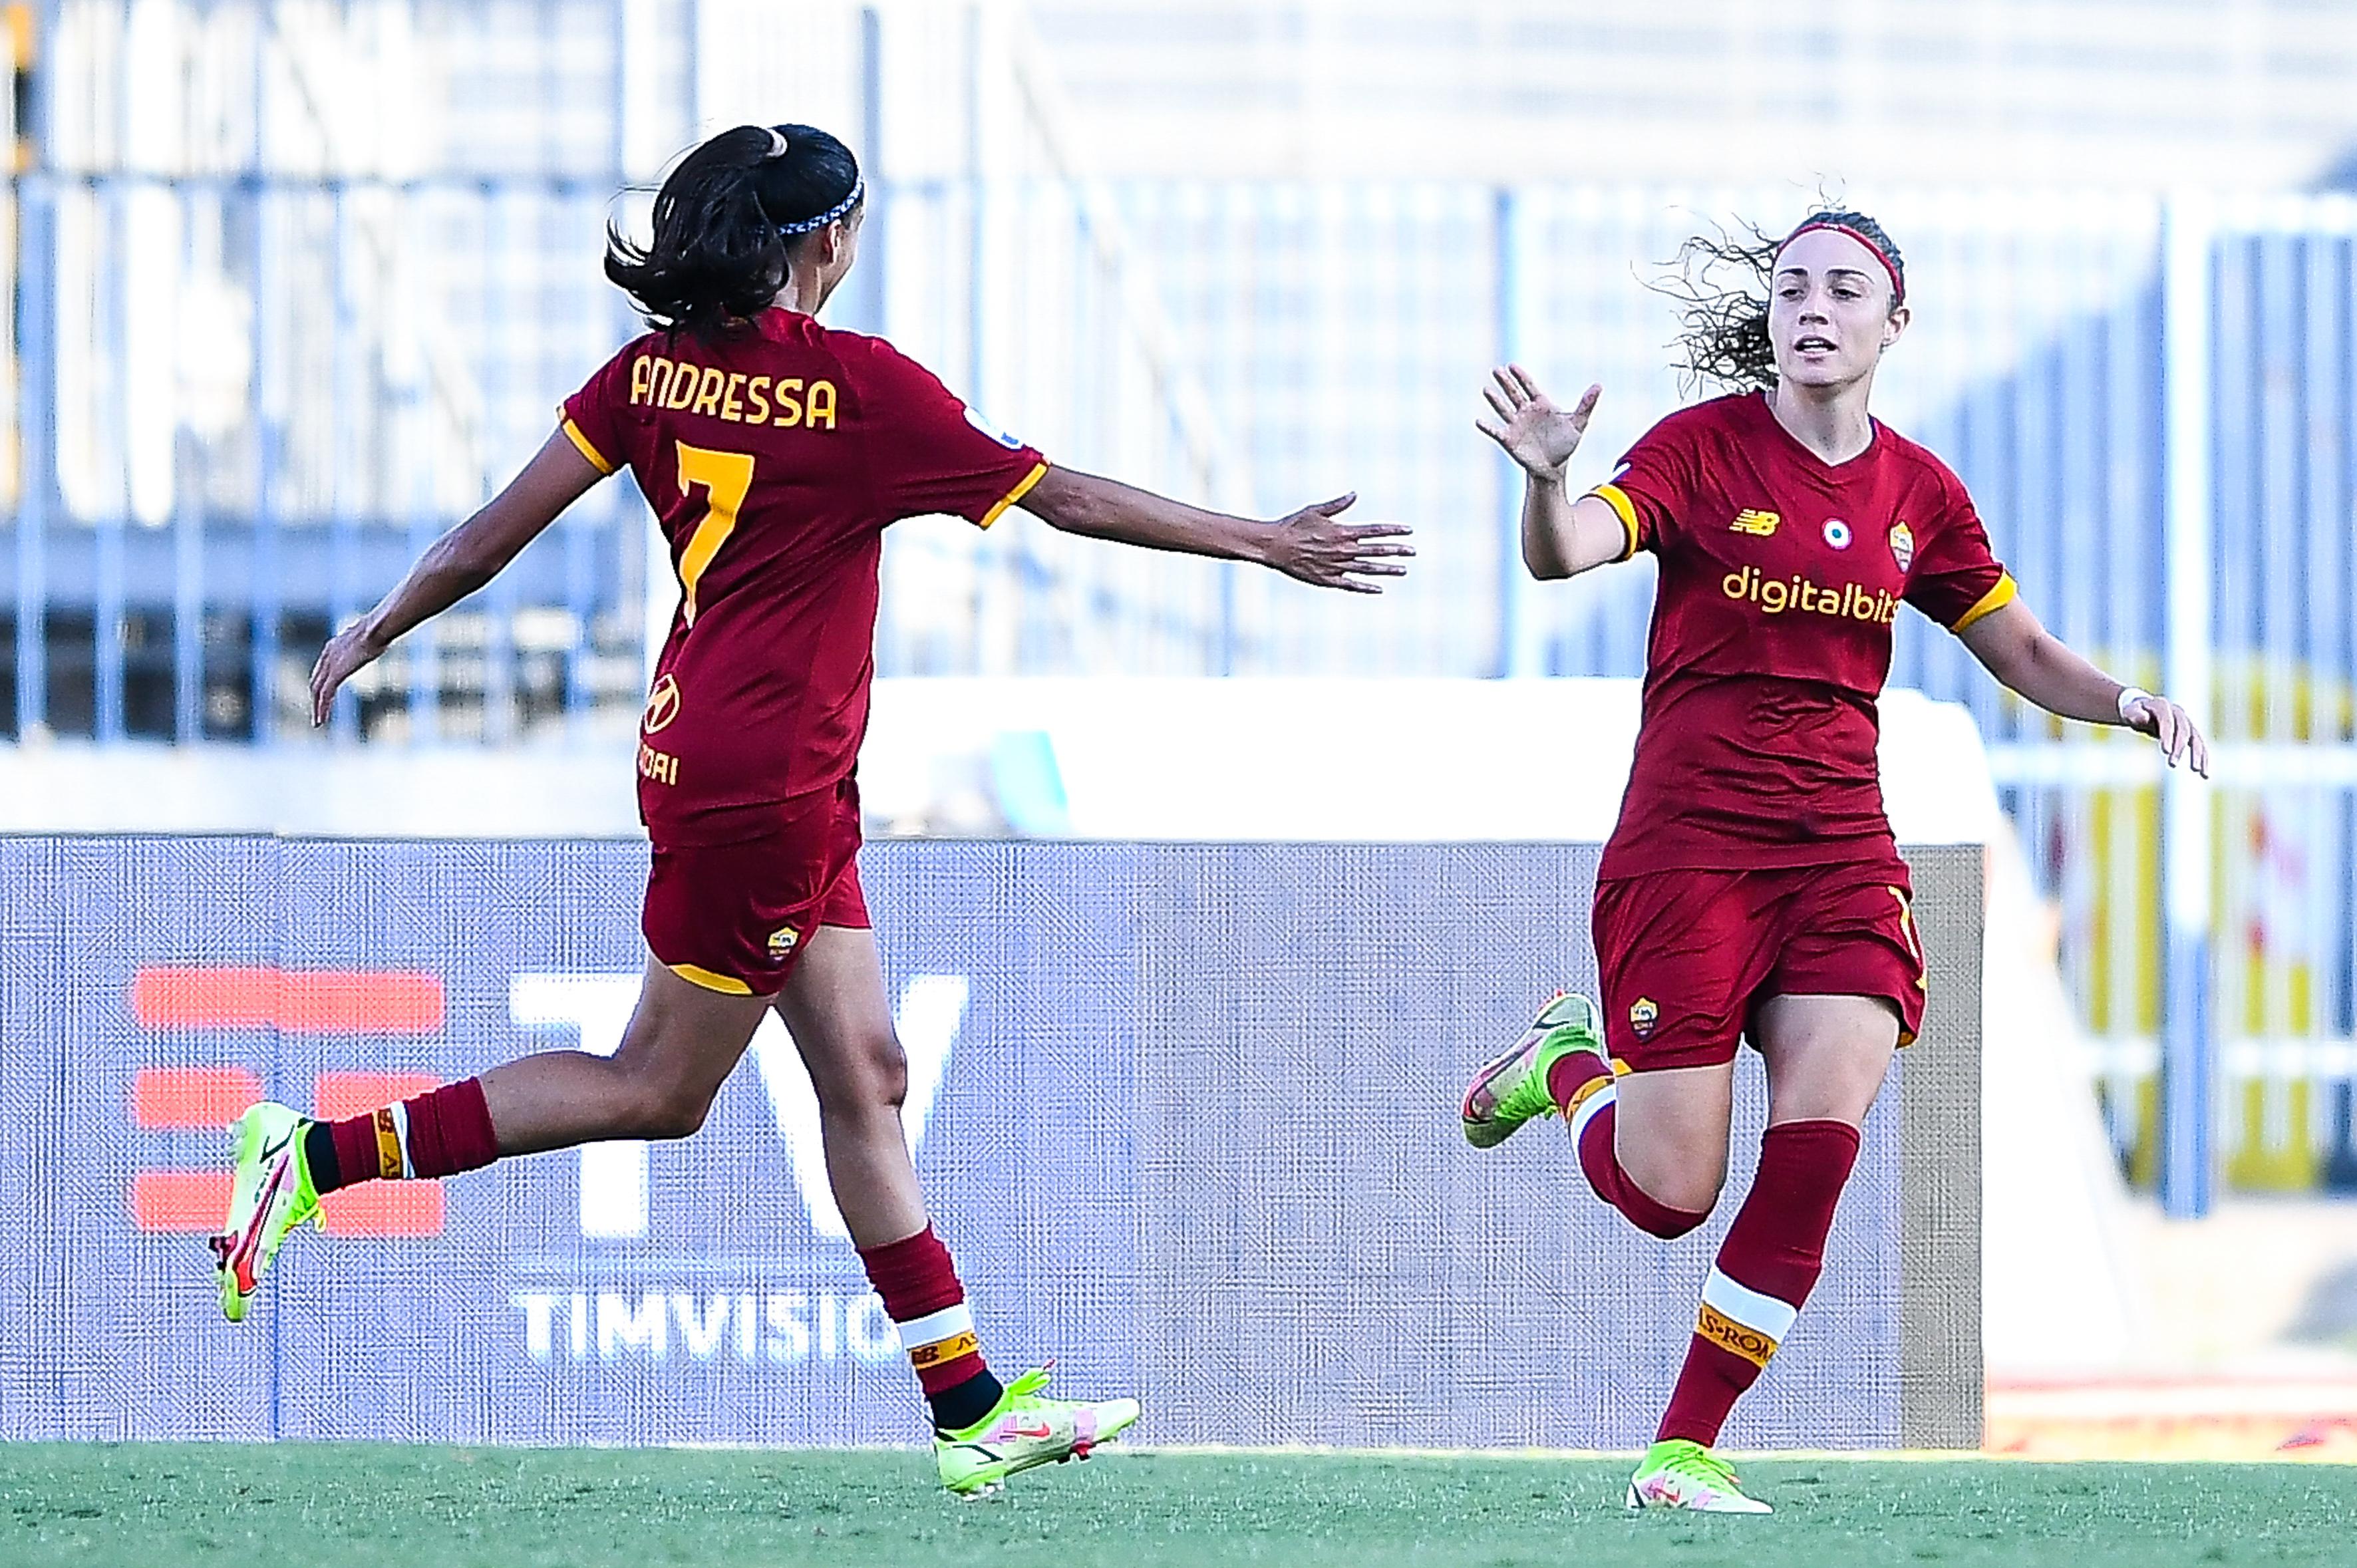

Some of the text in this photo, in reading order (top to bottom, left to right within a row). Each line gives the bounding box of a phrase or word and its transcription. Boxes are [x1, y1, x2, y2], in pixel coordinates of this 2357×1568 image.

[629, 354, 838, 430] ANDRESSA
[676, 440, 755, 629] 7
[510, 1293, 903, 1361] TIMVISIO
